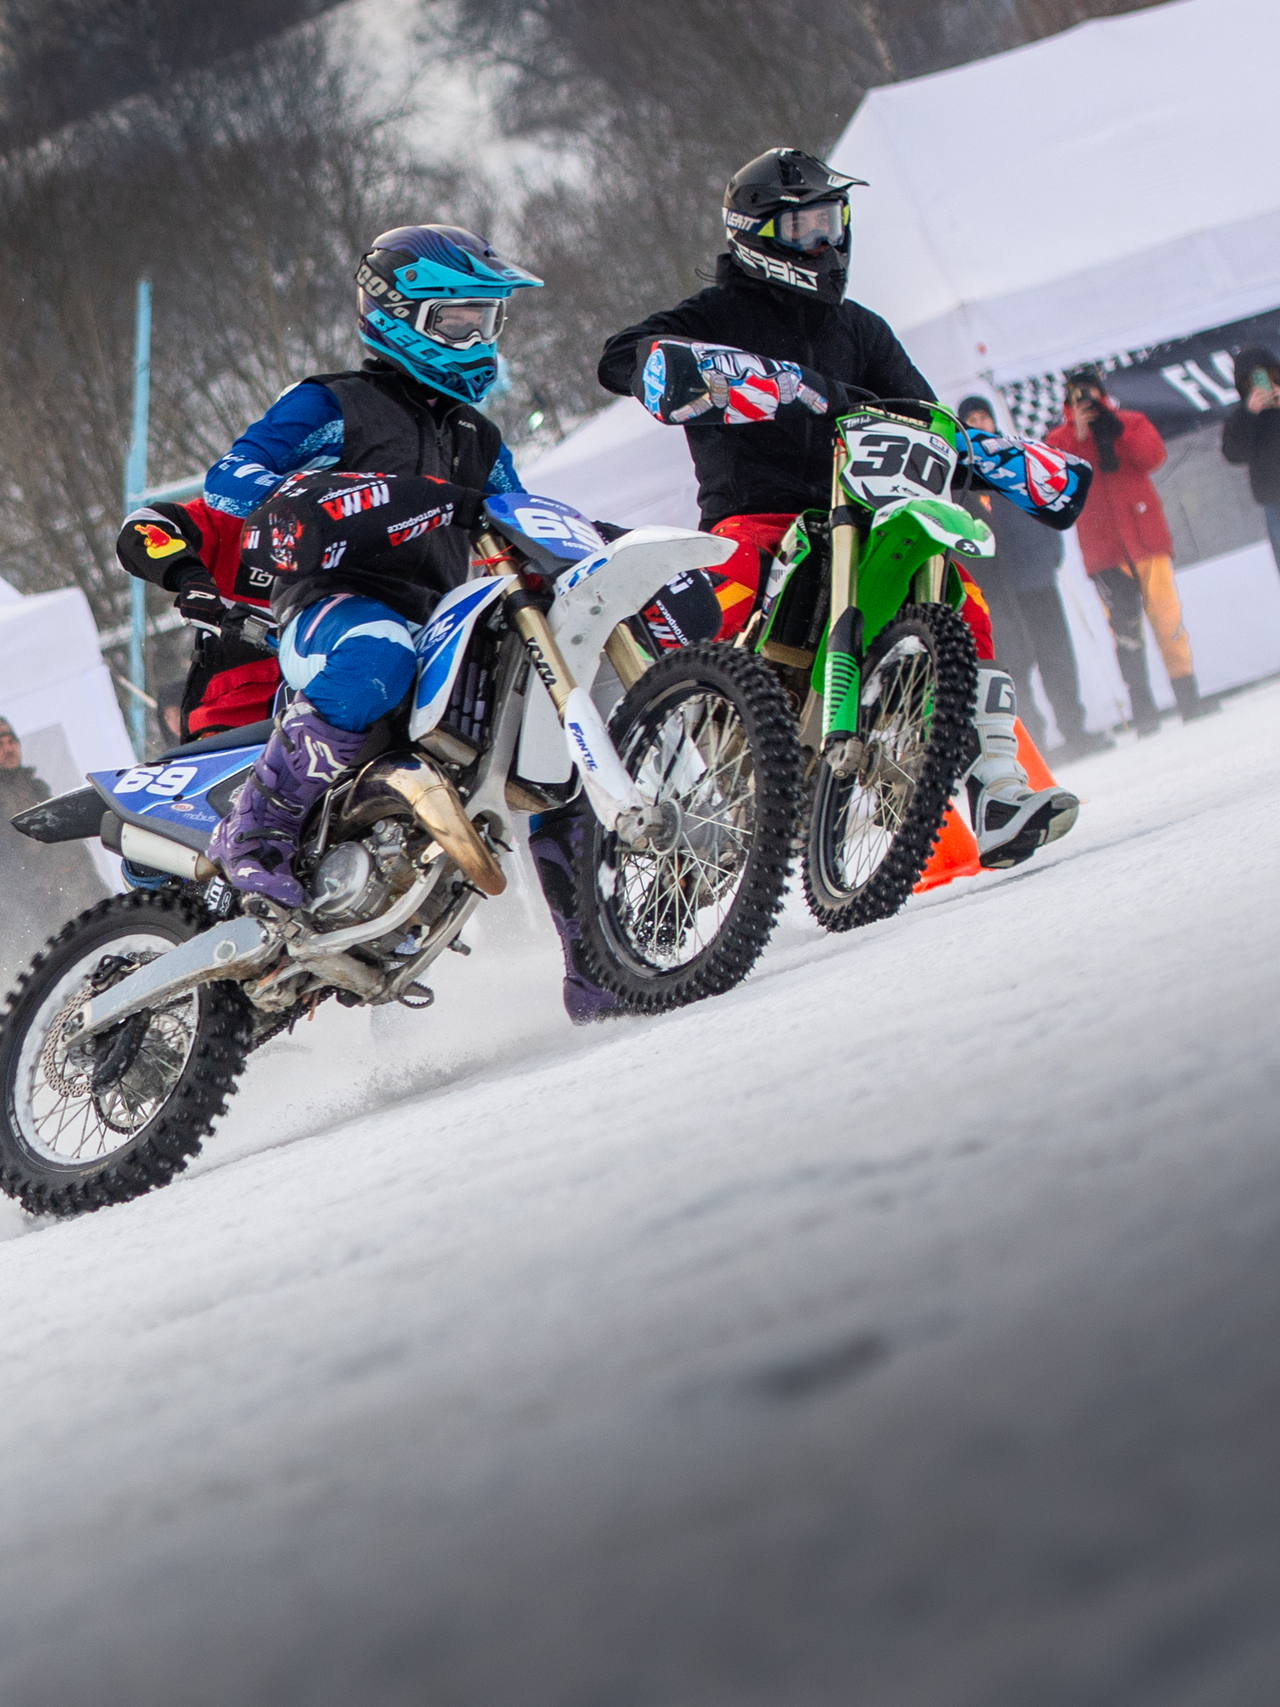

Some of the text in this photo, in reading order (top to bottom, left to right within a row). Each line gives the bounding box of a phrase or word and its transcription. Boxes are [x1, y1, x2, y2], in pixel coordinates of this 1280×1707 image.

[727, 210, 762, 230] LEATT
[366, 308, 465, 374] BELL
[849, 433, 952, 496] 30
[514, 507, 607, 553] 69
[568, 722, 598, 772] FANTIC
[112, 766, 199, 797] 69
[182, 811, 218, 824] mobius
